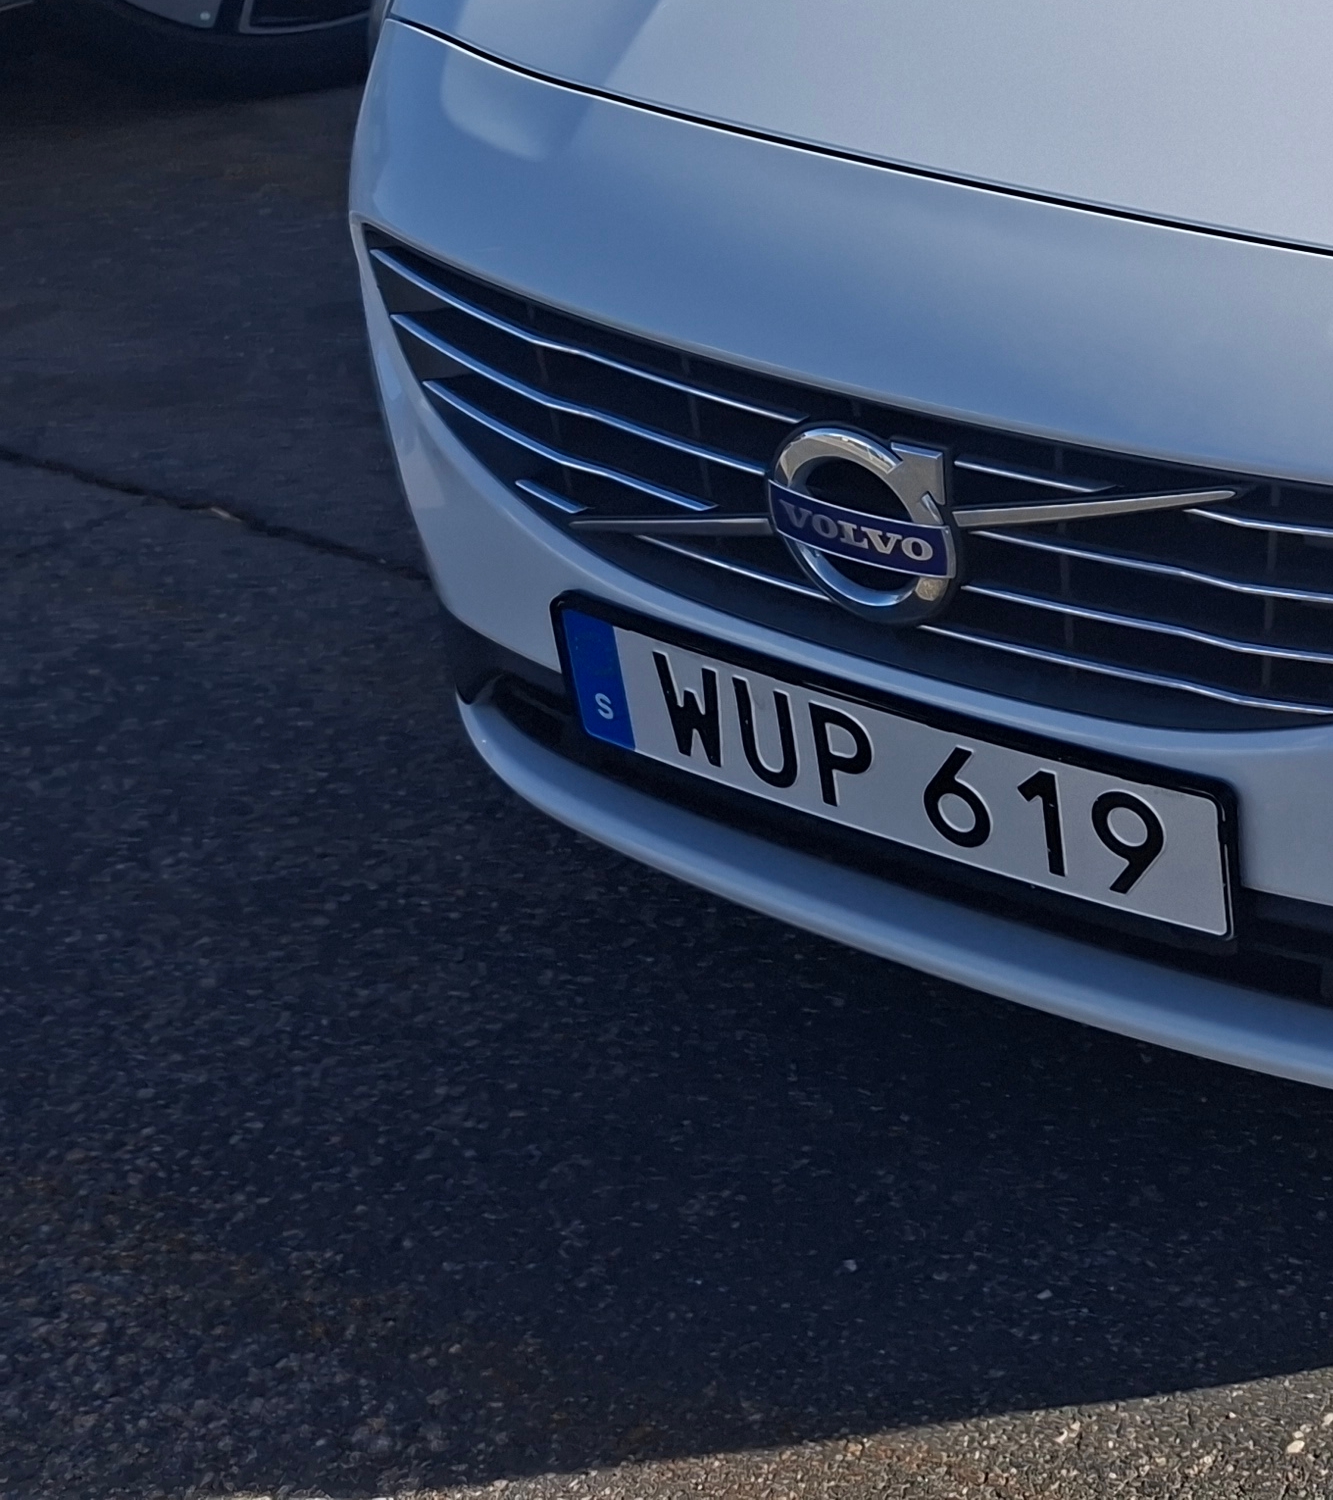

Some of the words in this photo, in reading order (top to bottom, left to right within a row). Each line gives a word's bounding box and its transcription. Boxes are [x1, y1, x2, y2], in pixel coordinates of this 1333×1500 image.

[779, 499, 934, 562] VOLVO
[595, 692, 614, 720] S
[651, 650, 875, 808] WUP
[922, 746, 1166, 896] 619
